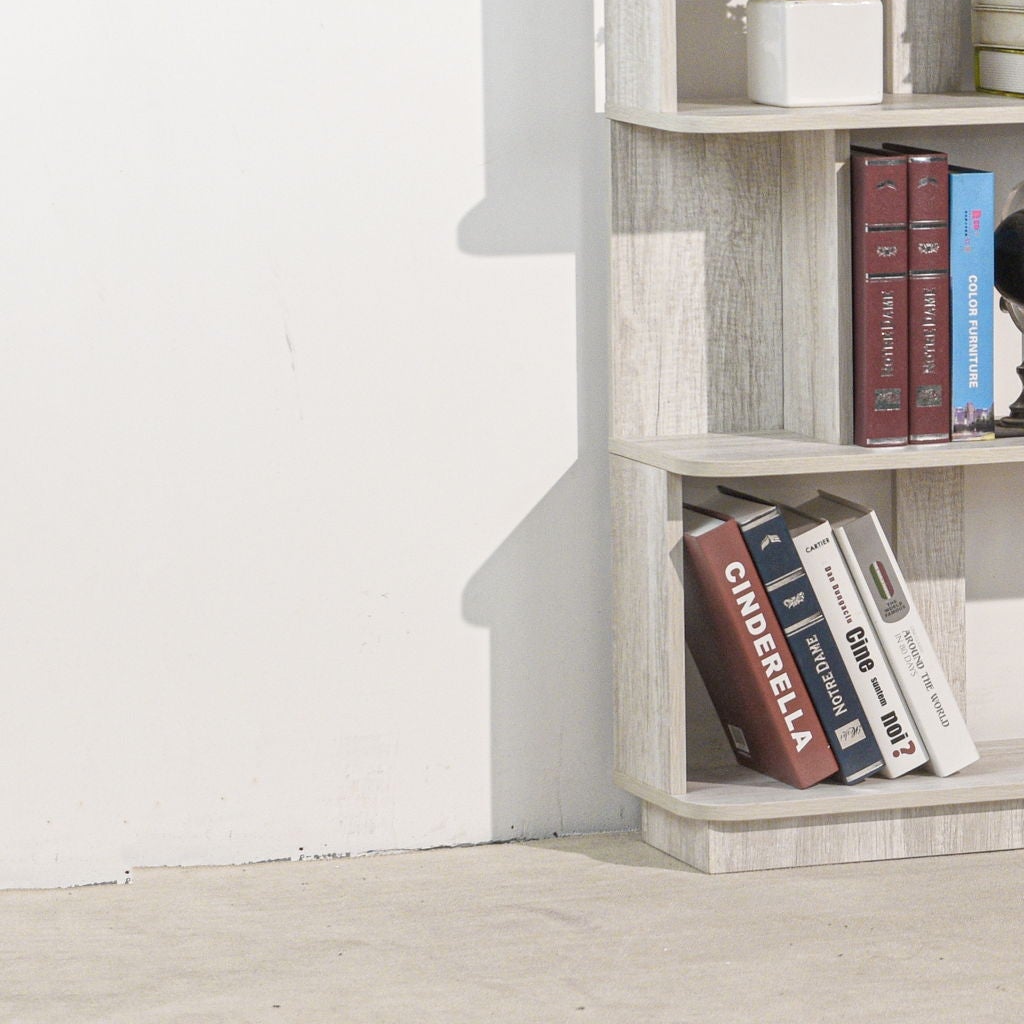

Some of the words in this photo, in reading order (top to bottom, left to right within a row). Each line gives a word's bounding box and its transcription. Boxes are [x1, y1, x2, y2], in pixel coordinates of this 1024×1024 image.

[968, 275, 978, 317] COLOR
[968, 319, 979, 389] FURNITURE
[805, 537, 831, 554] CARTIER
[724, 560, 813, 753] CINDERELLA
[805, 634, 830, 674] DAME
[845, 626, 875, 674] Cine
[871, 677, 888, 707] suntem
[895, 633, 903, 644] IN
[904, 655, 918, 678] DAYS
[822, 670, 848, 717] NOTRE
[902, 630, 926, 670] AROUND
[921, 671, 935, 692] THE
[931, 693, 951, 728] WORLD
